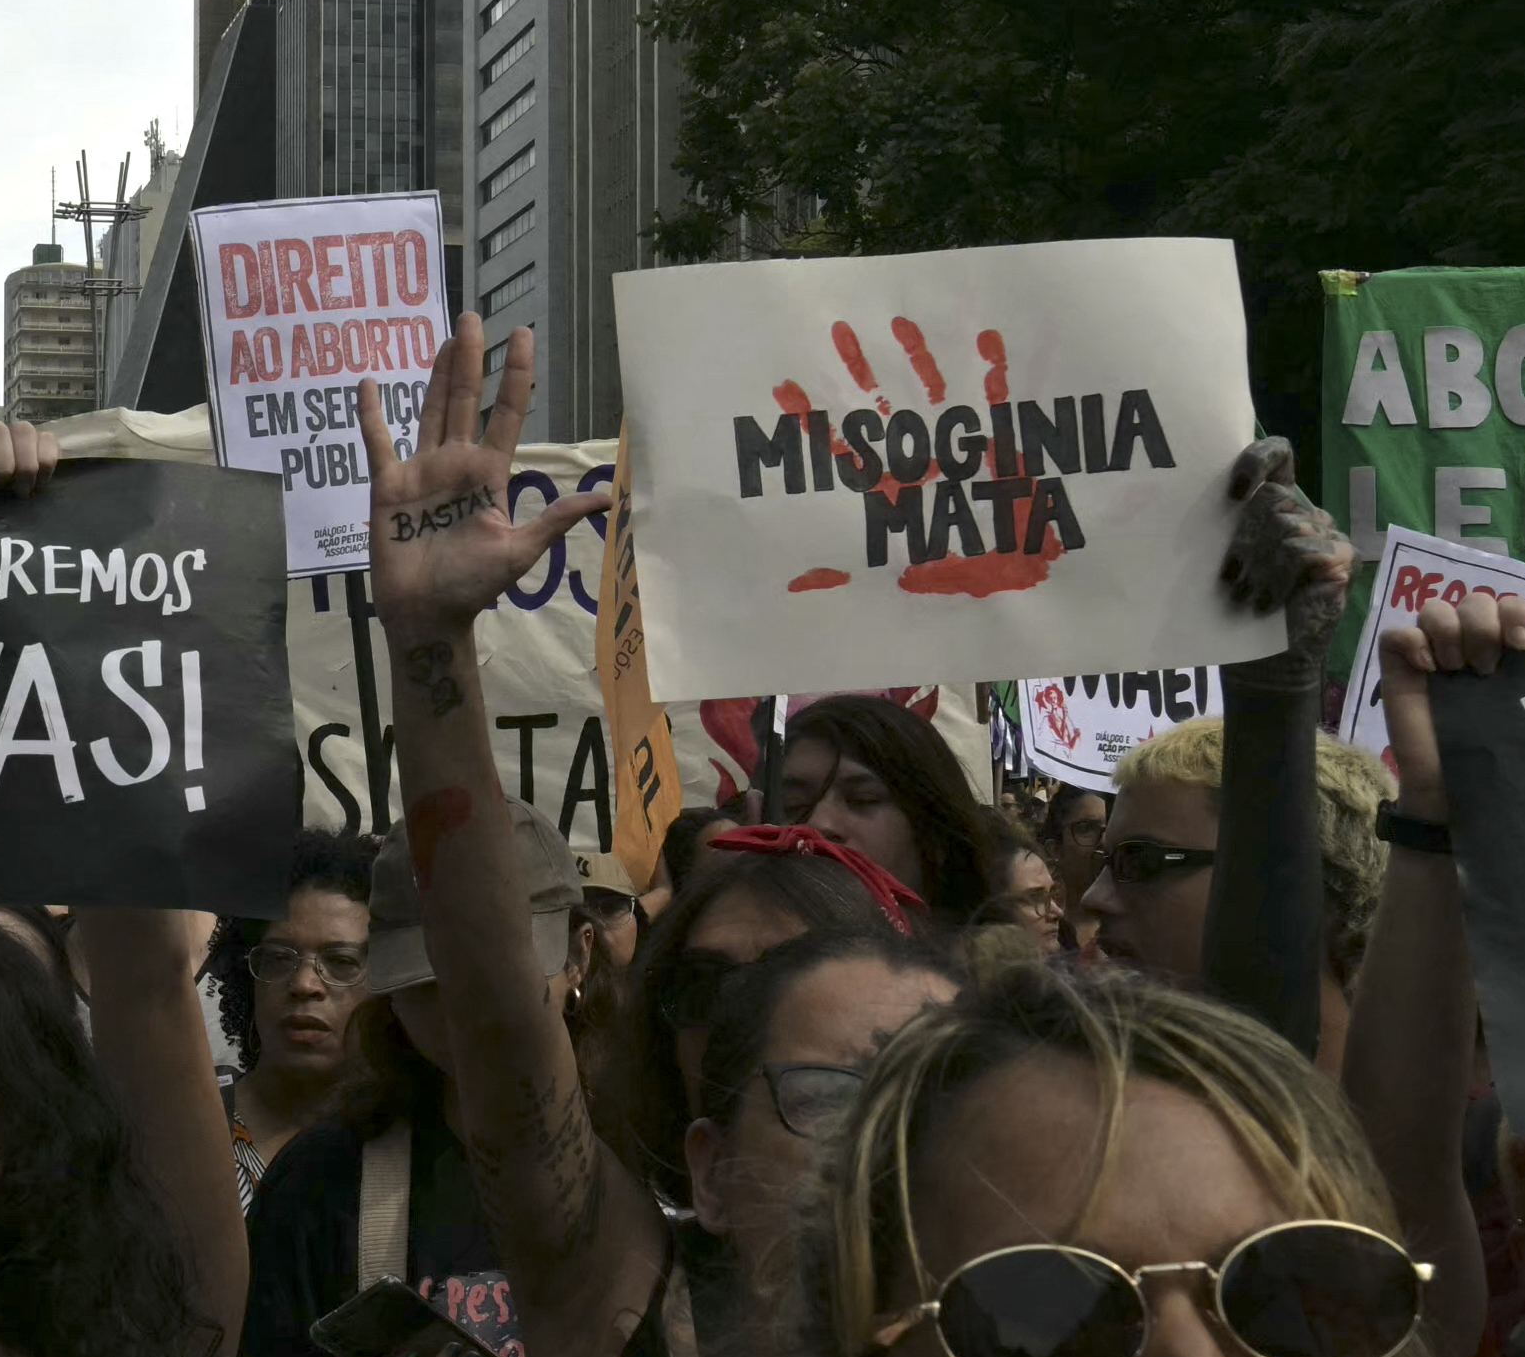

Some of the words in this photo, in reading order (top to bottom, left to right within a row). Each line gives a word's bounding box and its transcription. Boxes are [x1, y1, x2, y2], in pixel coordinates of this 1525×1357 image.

[219, 229, 429, 319] DIREITO
[230, 327, 284, 385] AO
[291, 316, 437, 378] ABORTO
[245, 391, 299, 438] EM
[733, 389, 1175, 498] MISOGINIA
[314, 525, 347, 539] DIÁLOGO
[349, 524, 355, 532] E
[317, 537, 340, 550] AÇÃO
[389, 485, 496, 542] BASTA!
[865, 477, 1086, 567] MATA
